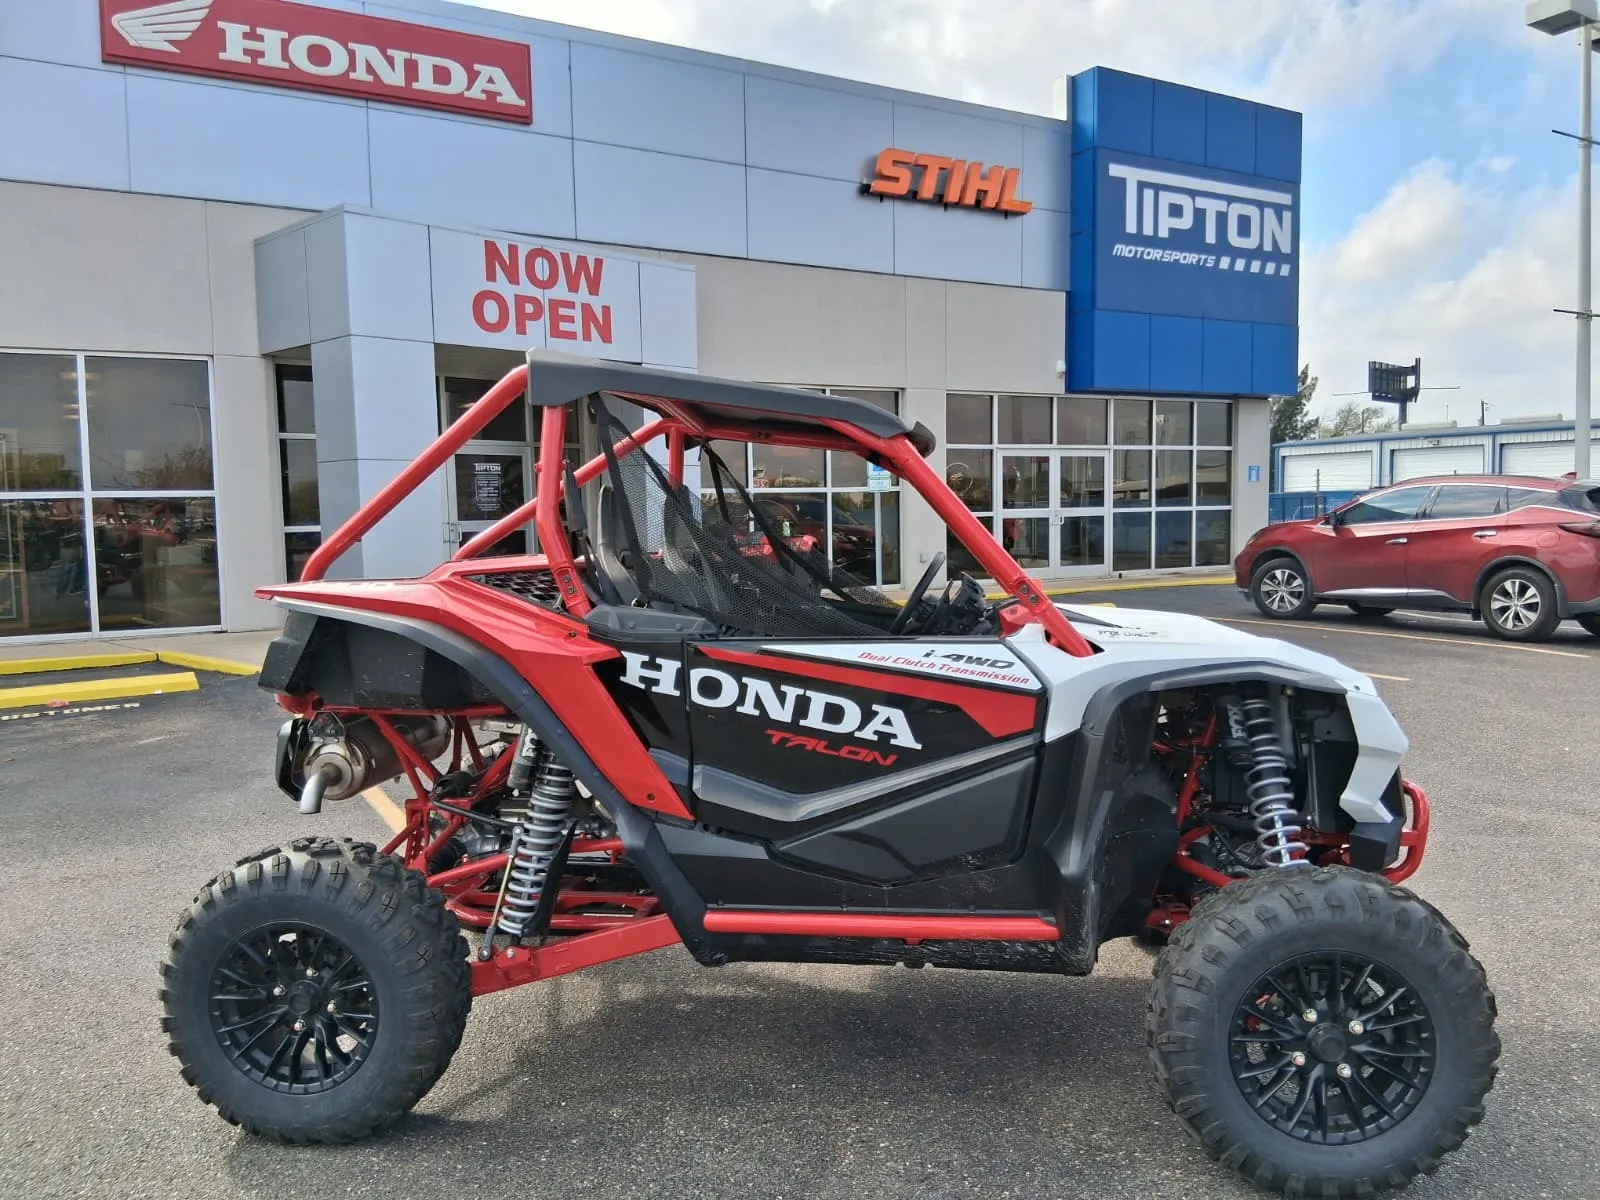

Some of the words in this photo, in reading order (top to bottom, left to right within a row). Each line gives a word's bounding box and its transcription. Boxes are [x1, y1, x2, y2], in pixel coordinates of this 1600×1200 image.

[217, 20, 526, 106] HONDA
[871, 147, 1033, 214] STIHL
[1108, 163, 1292, 254] TIPTON
[484, 239, 604, 296] NOW
[1112, 243, 1217, 267] MOTORSPORTS
[472, 289, 613, 344] OPEN
[858, 652, 890, 663] Dual
[892, 656, 936, 670] Clutch
[938, 663, 1030, 685] Transmission
[922, 650, 1015, 670] i-4WD
[620, 650, 922, 750] HONDA
[764, 728, 897, 767] TALON
